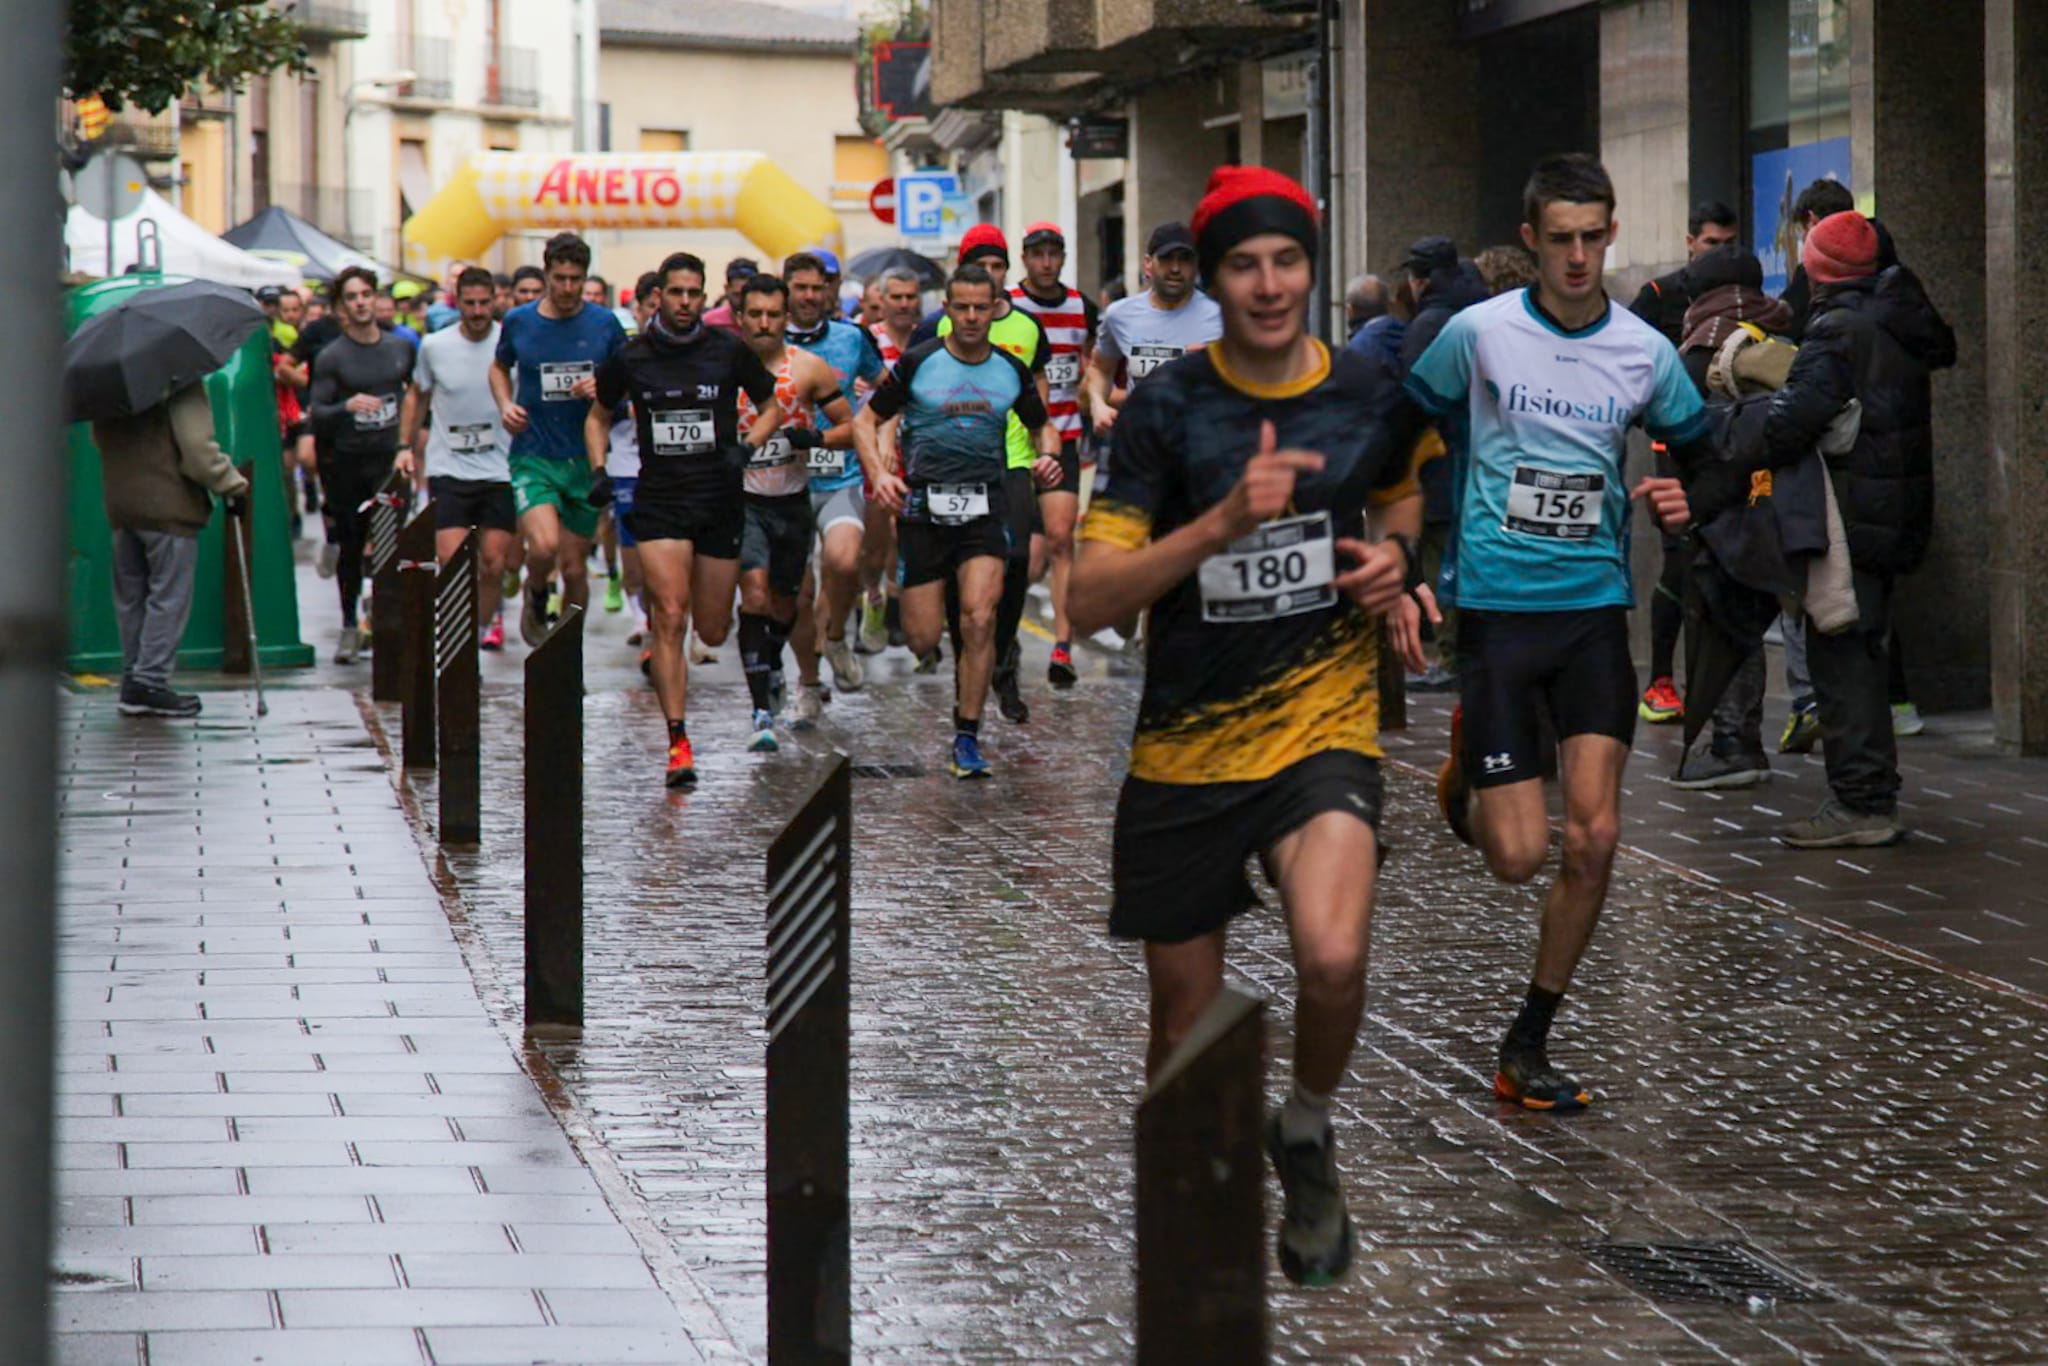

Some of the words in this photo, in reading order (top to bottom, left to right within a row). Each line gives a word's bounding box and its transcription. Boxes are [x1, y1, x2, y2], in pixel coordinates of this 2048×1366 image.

[534, 159, 680, 207] ANETO
[908, 182, 943, 229] P
[668, 425, 701, 441] 170
[948, 496, 969, 511] 57
[1534, 493, 1585, 519] 156
[1232, 551, 1306, 592] 180
